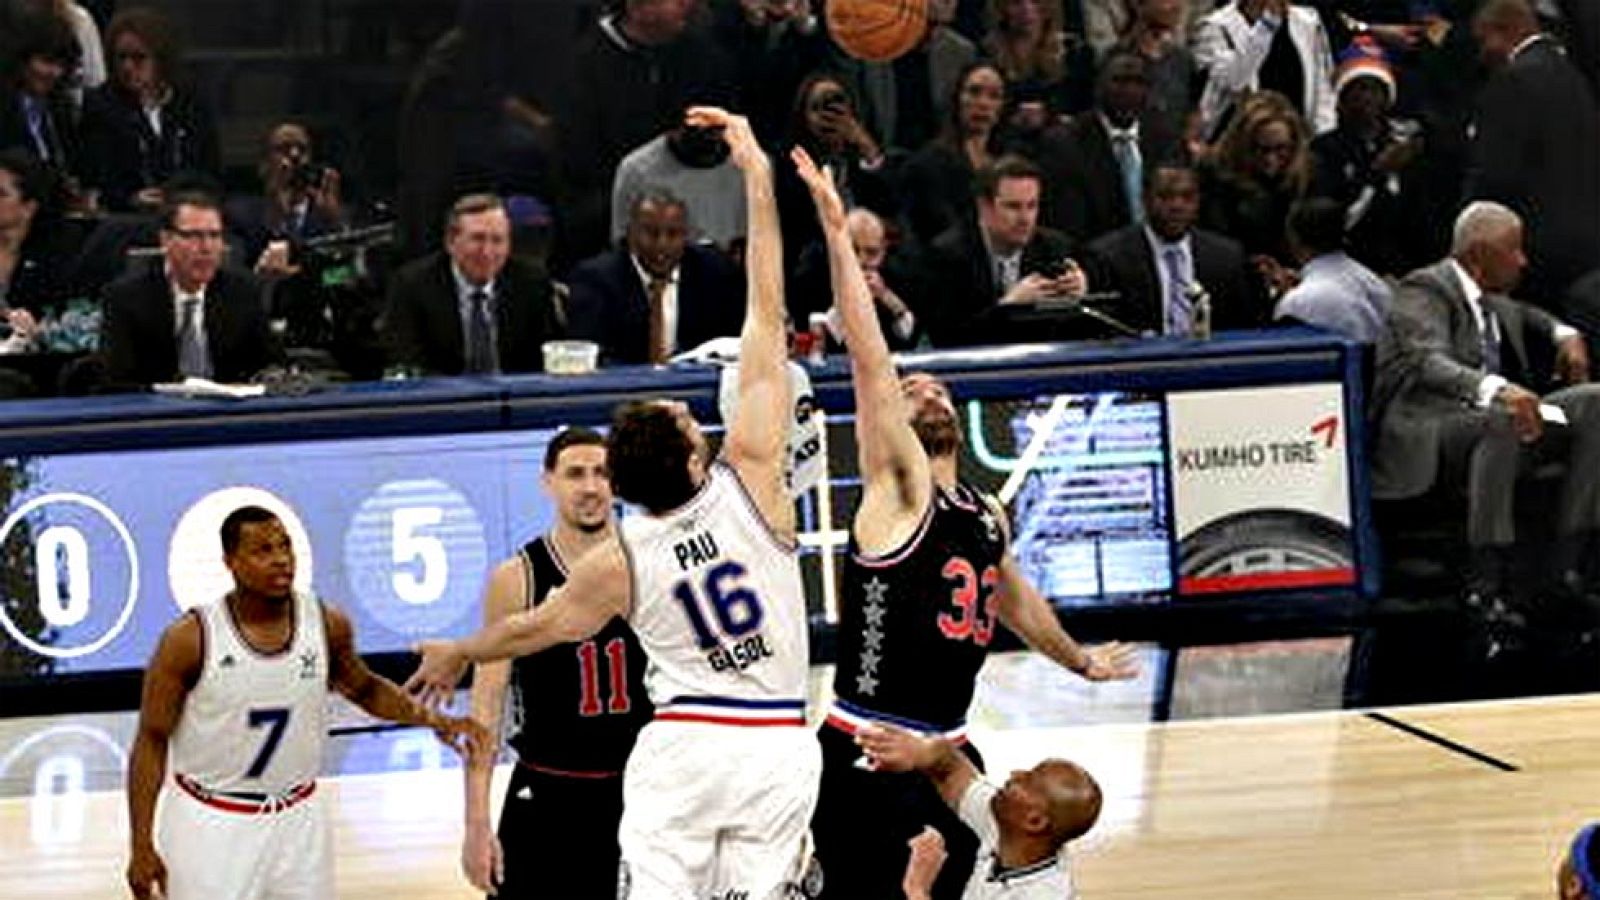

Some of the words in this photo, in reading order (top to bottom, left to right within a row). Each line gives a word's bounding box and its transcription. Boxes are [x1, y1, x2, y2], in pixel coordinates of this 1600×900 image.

[1178, 443, 1265, 470] KUMHO
[1268, 440, 1316, 464] TIRE
[391, 507, 448, 605] 5
[673, 530, 719, 571] PAU
[673, 560, 764, 649] 16
[576, 637, 631, 717] 11
[708, 634, 774, 671] GASOL
[246, 708, 290, 779] 7
